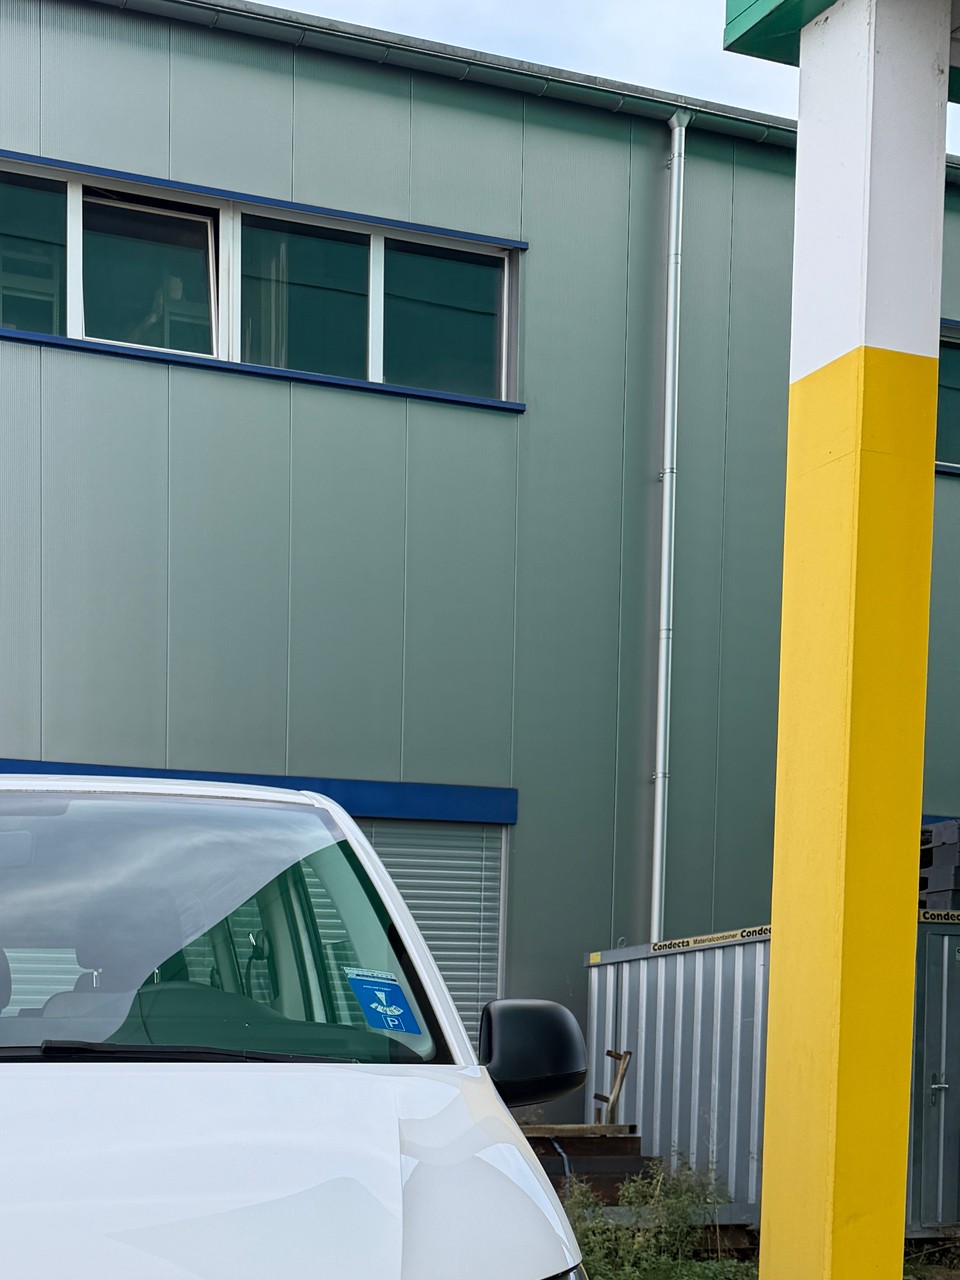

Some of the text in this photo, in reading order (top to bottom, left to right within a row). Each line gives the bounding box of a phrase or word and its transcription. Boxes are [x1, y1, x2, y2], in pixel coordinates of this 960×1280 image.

[652, 940, 690, 952] Condecta
[692, 932, 738, 945] Materialcontainer
[386, 1016, 399, 1028] P
